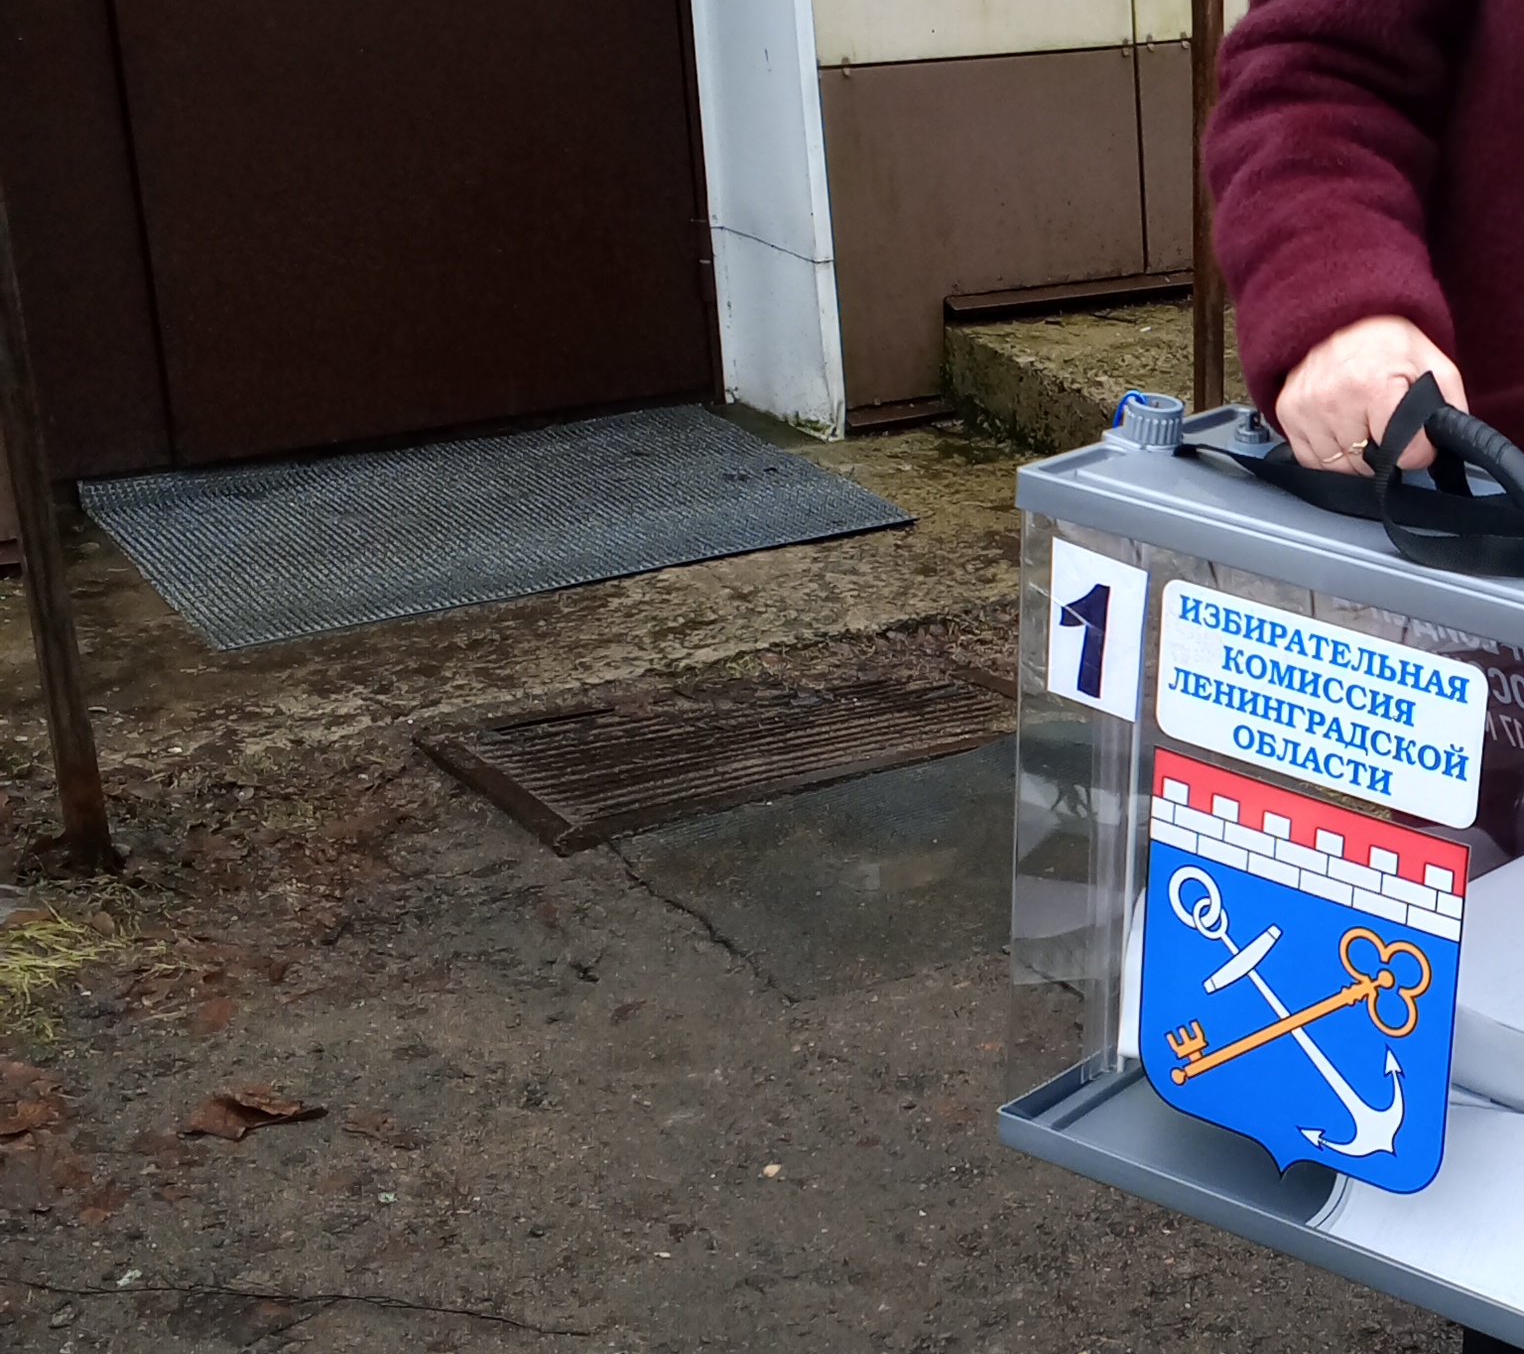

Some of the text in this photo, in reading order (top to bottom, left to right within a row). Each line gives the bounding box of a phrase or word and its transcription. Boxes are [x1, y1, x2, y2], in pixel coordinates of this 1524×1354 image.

[1059, 583, 1111, 699] 1
[1178, 593, 1471, 705] ИЗБИРАТЕЛЬНАЯ
[1221, 644, 1418, 729] КОМИССИЯ
[1168, 666, 1470, 783] ЛЕНИНГРАДСКОЙ
[1231, 724, 1394, 798] ОБЛАСТИ
